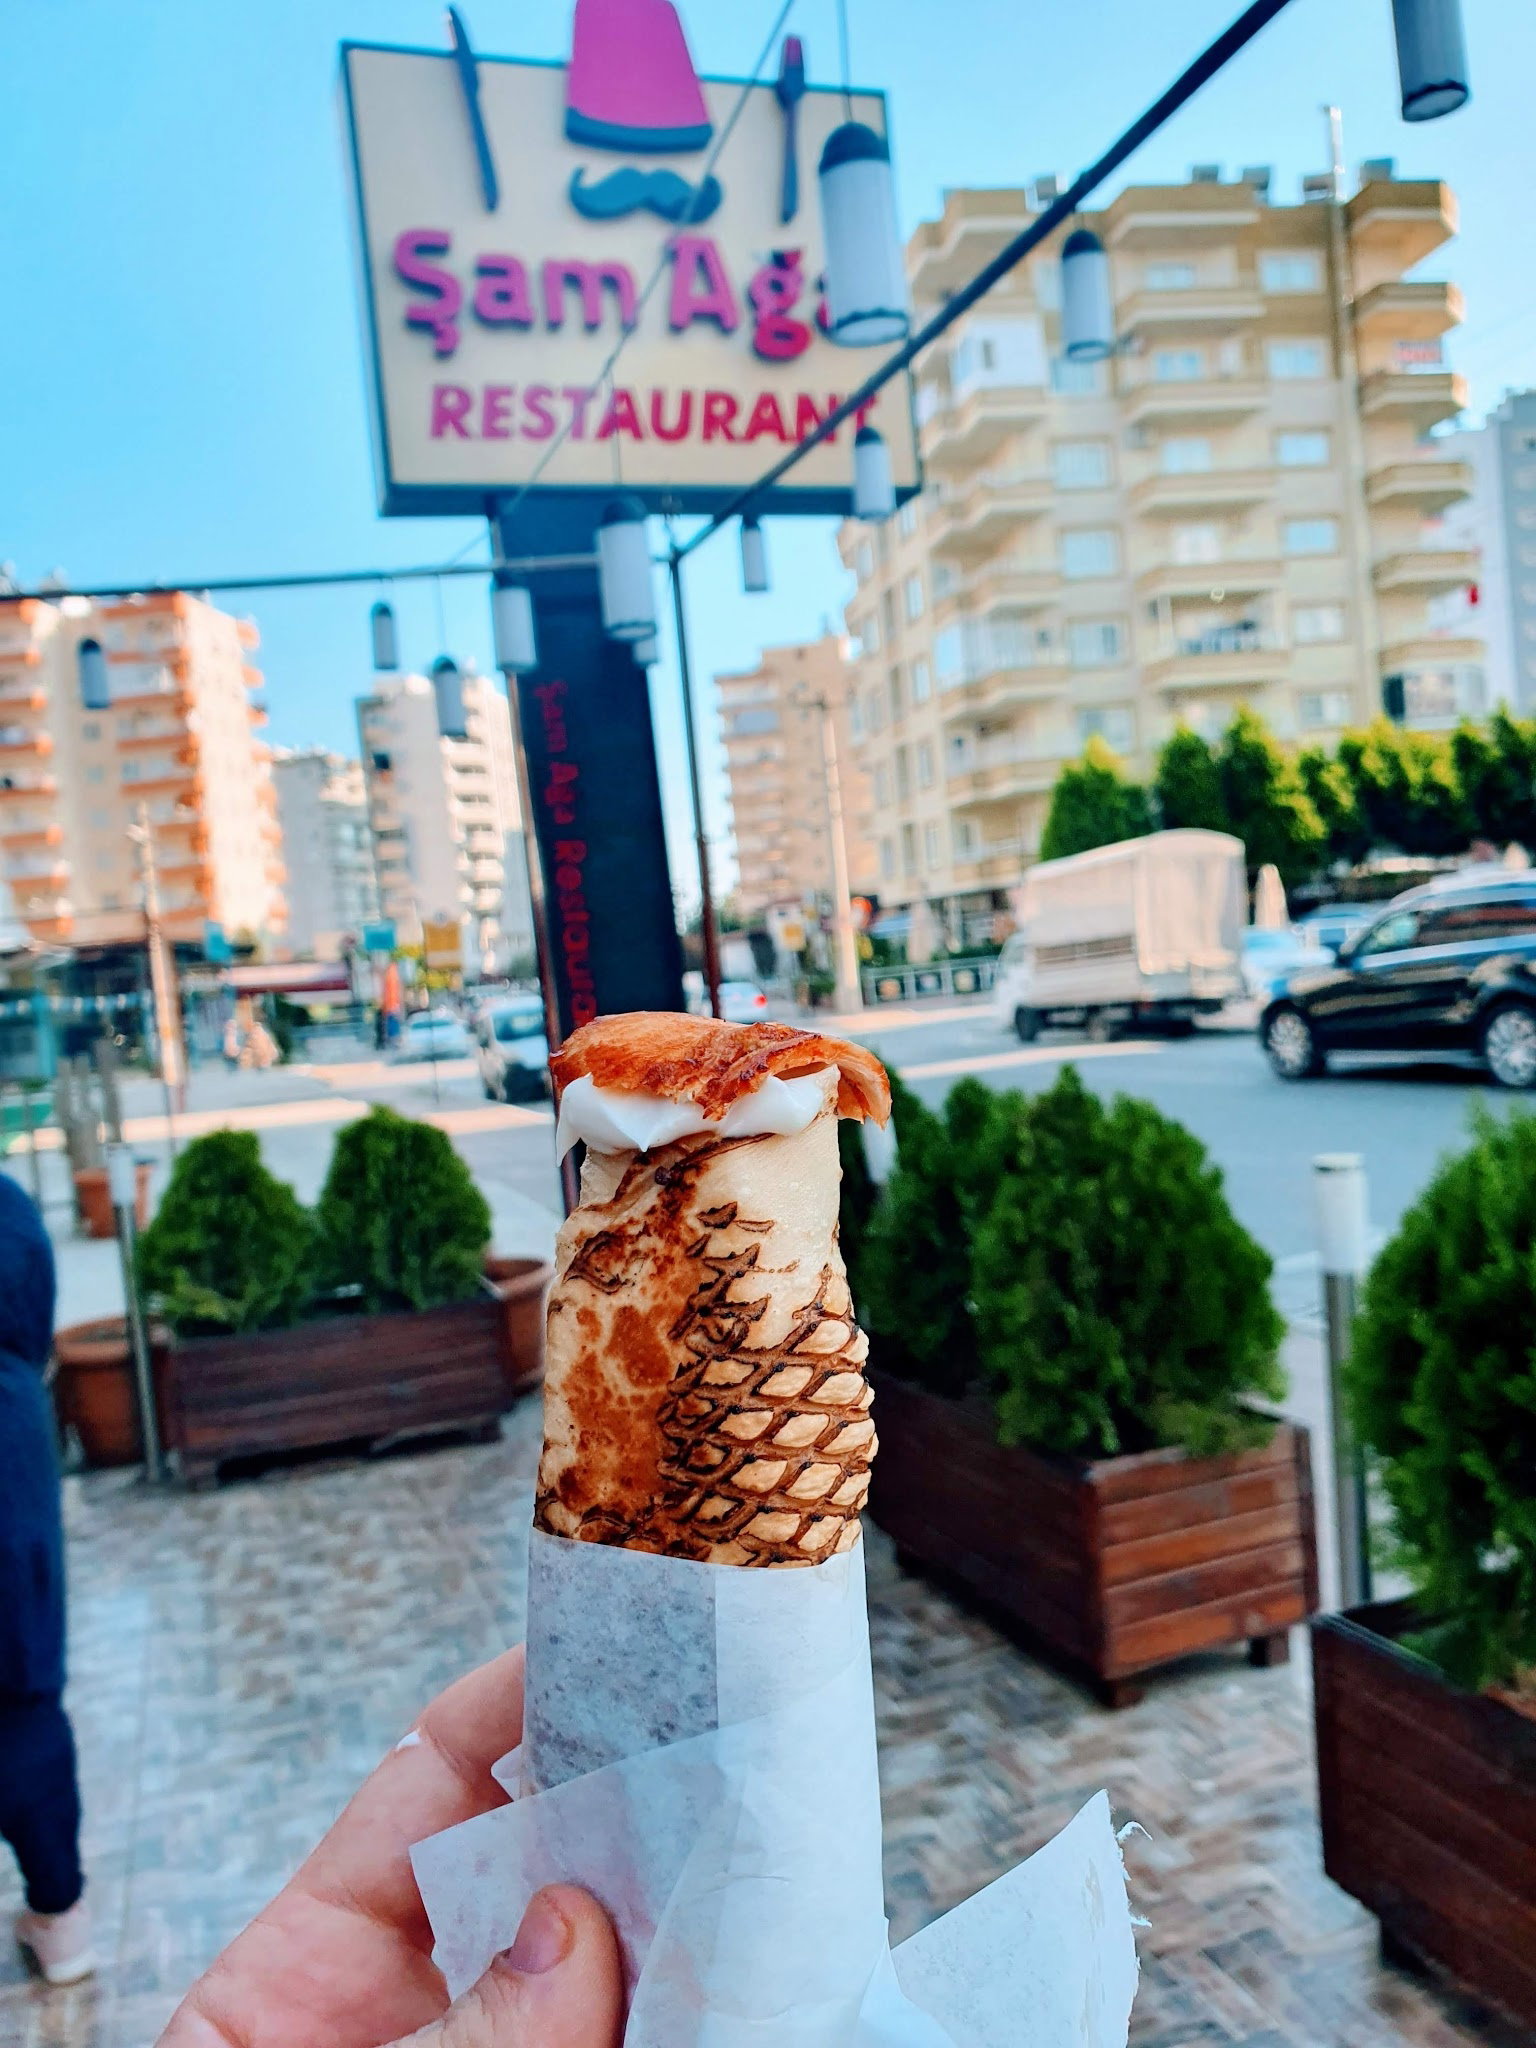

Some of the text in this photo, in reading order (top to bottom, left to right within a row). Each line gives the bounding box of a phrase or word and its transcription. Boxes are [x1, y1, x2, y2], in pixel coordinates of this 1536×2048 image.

[393, 229, 832, 360] Şam Ağ
[554, 839, 597, 1028] Restaura
